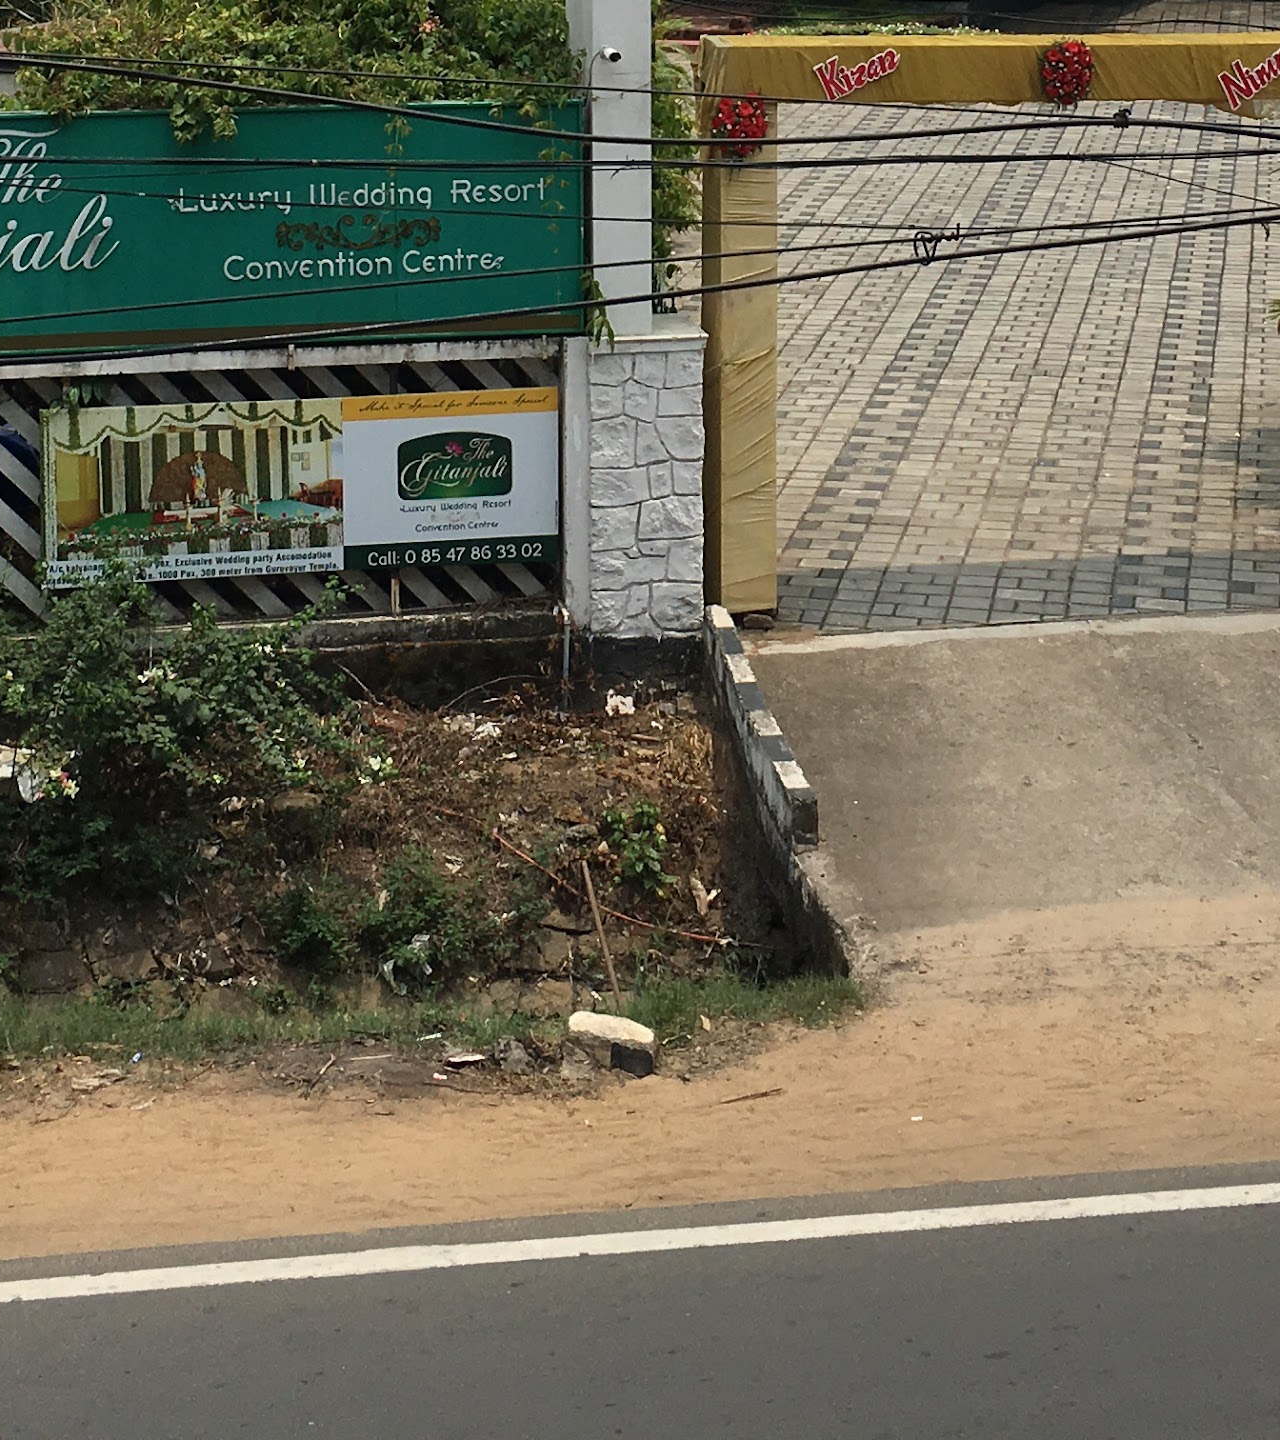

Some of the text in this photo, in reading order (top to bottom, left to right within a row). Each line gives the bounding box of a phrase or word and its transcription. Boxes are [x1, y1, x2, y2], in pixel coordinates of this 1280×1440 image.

[167, 178, 547, 215] Luxury Wedding Resort
[223, 247, 504, 281] Convention Centre
[463, 438, 494, 462] The
[401, 452, 508, 497] Gitanjali
[400, 499, 511, 513] Luxury Wedding Resort
[415, 523, 465, 533] Convention
[175, 557, 212, 567] Exclusive
[216, 555, 250, 565] Wedding
[253, 554, 273, 565] party
[276, 551, 331, 561] Accomodation
[368, 543, 542, 566] Call: 0 85 47 86 33 02
[201, 569, 216, 577] 300
